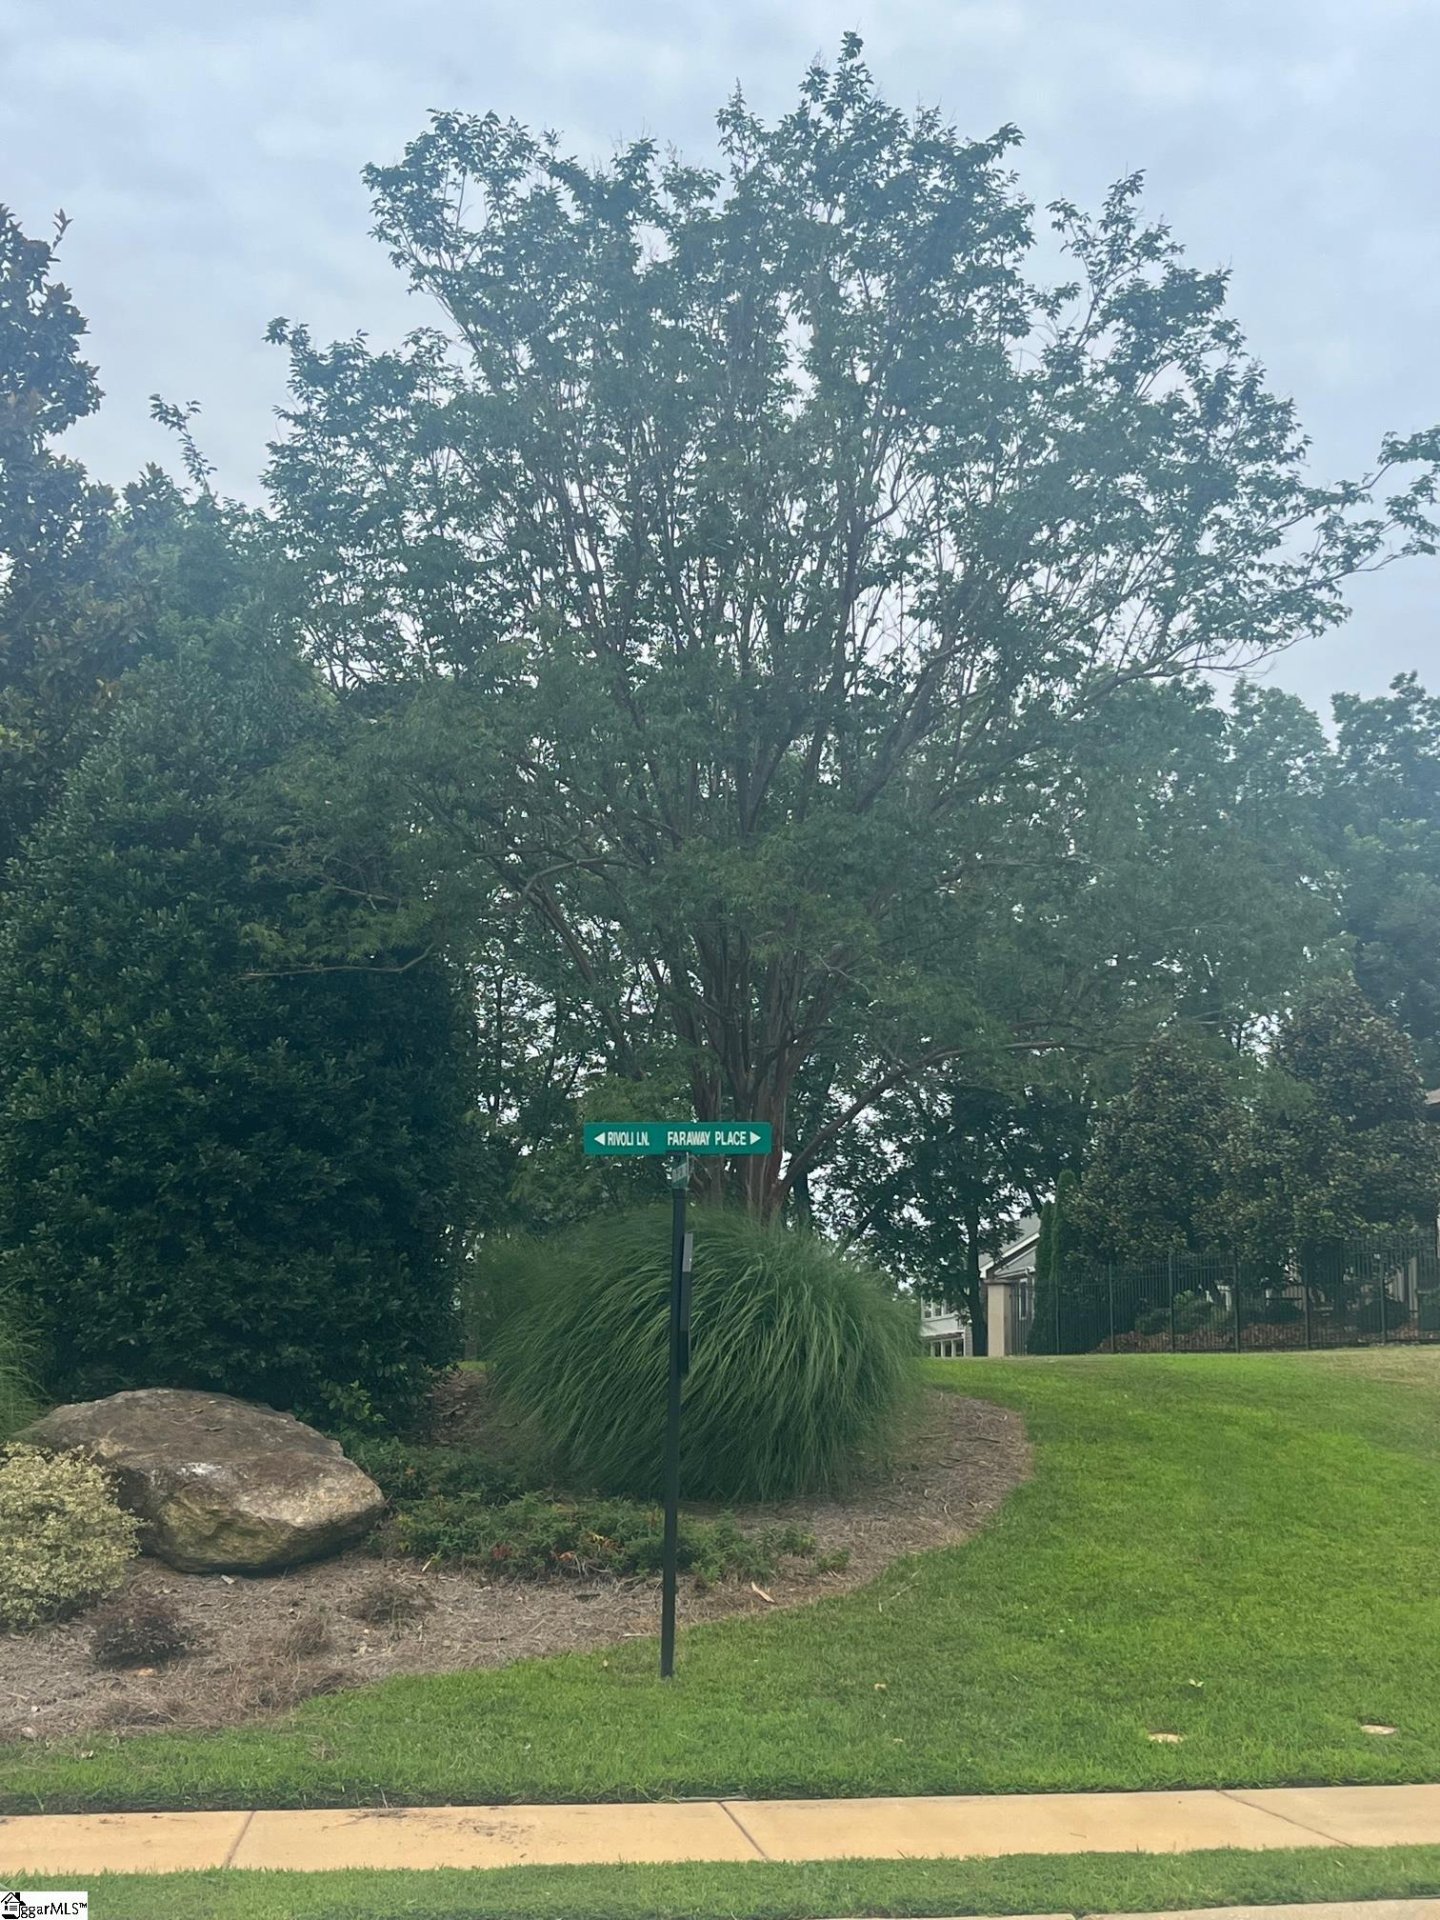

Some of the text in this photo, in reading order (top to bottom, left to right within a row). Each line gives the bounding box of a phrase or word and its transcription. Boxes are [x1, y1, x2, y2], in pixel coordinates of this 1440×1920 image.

[607, 1131, 650, 1146] RIVOLI LN.
[667, 1131, 747, 1146] FARAWAY PLACE
